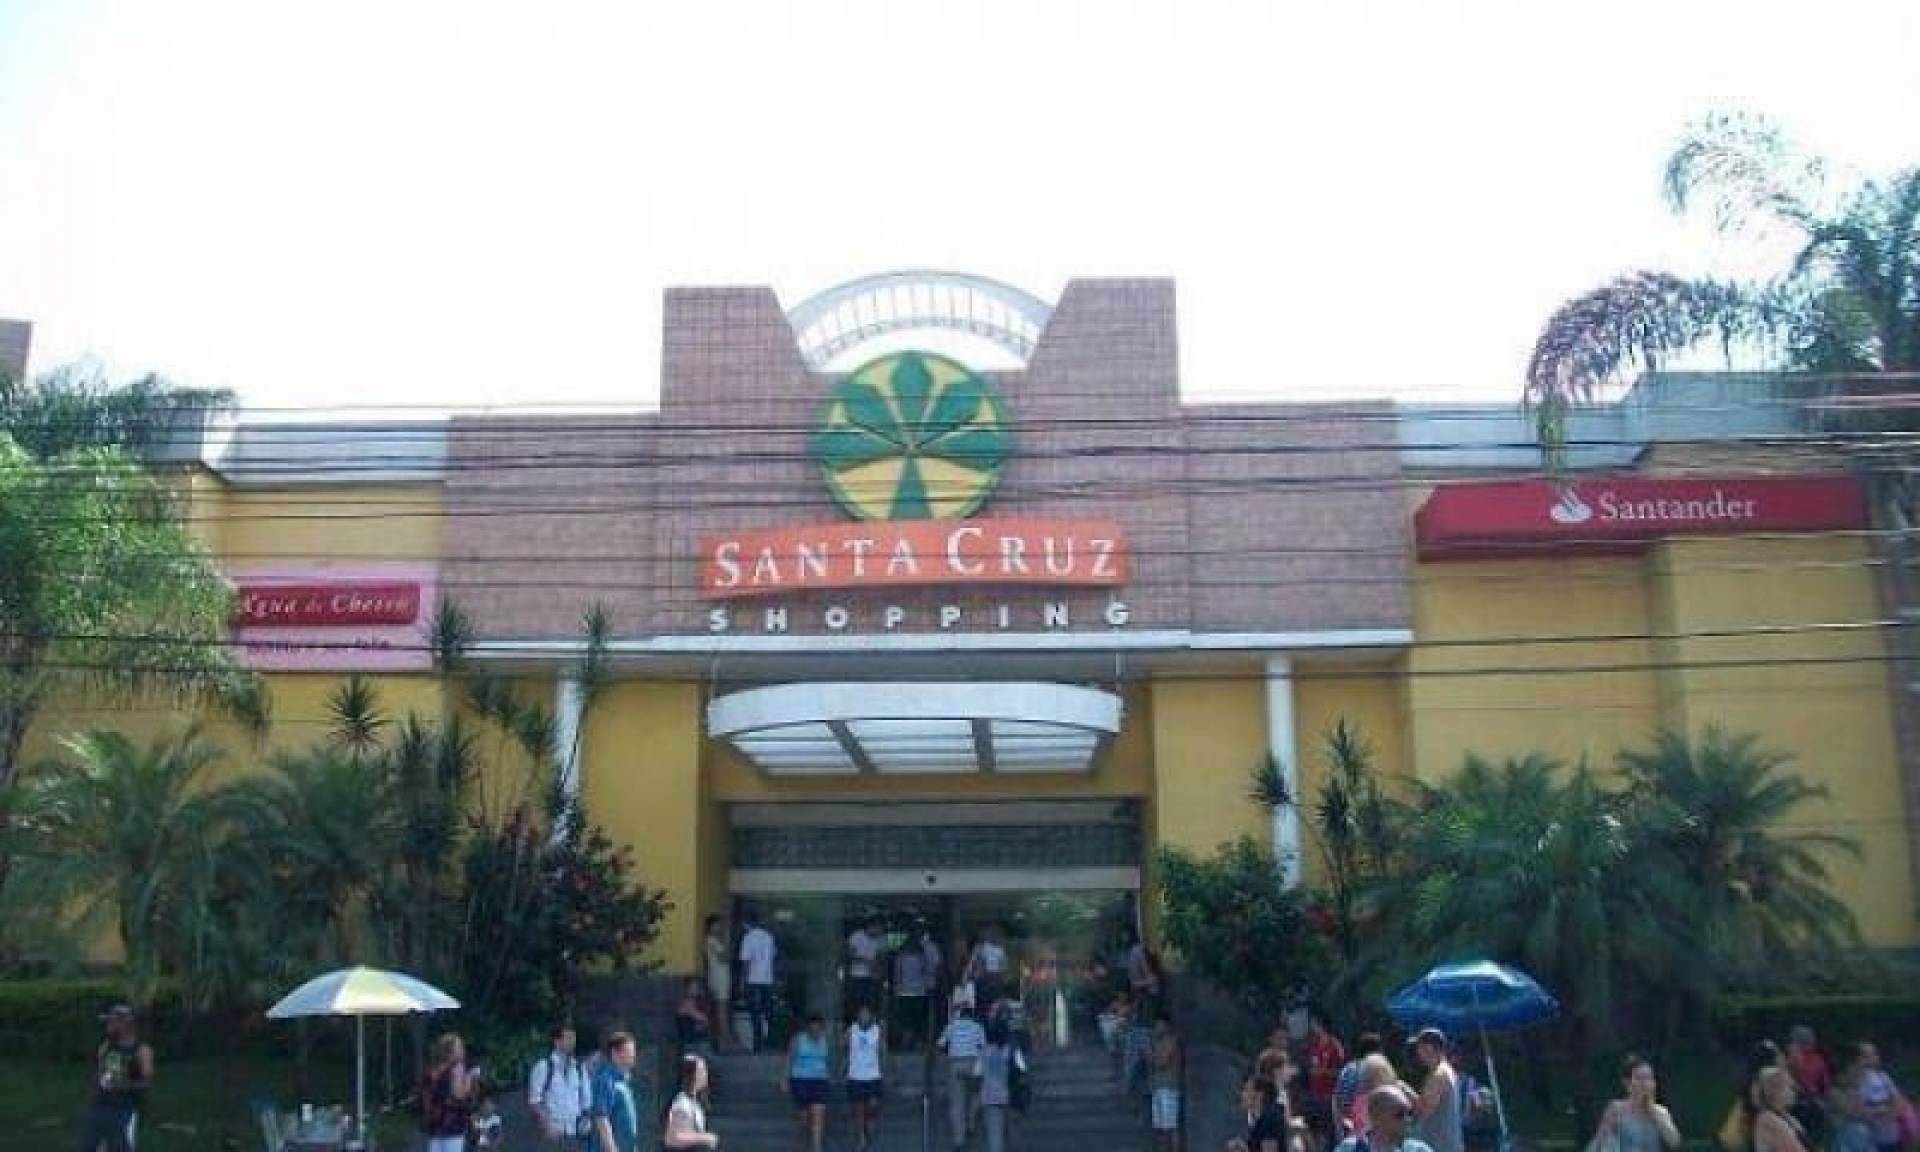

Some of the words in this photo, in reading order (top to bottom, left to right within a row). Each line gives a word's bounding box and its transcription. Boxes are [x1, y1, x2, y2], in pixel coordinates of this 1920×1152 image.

[1599, 488, 1757, 520] Santander
[713, 537, 918, 588] SANTA
[946, 526, 1117, 578] CRUZ
[709, 601, 1130, 632] SHOPPING
